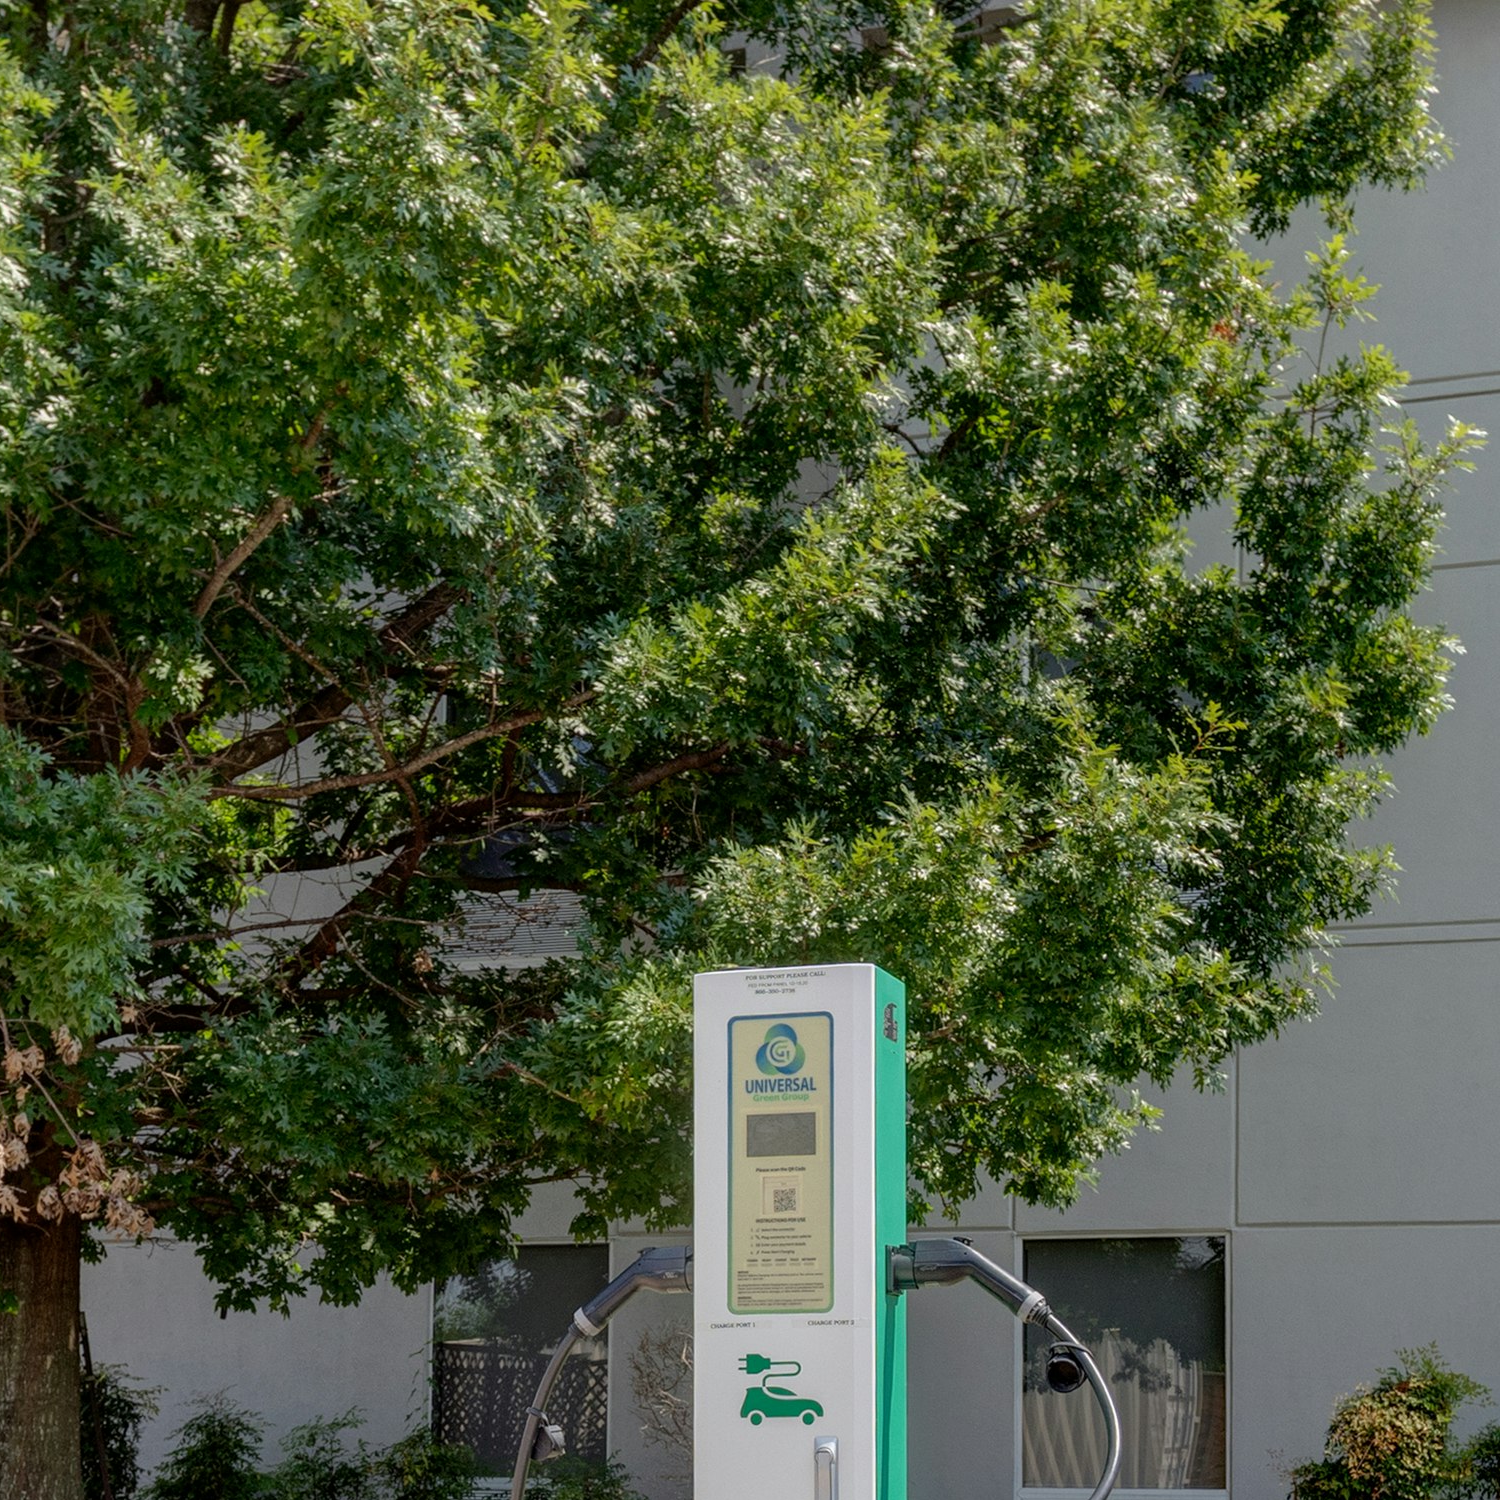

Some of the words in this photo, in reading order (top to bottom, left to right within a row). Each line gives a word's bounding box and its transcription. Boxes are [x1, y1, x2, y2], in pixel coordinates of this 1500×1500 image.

[745, 1077, 817, 1094] UNIVERSAL
[753, 1094, 780, 1102] Green
[781, 1093, 810, 1101] Group
